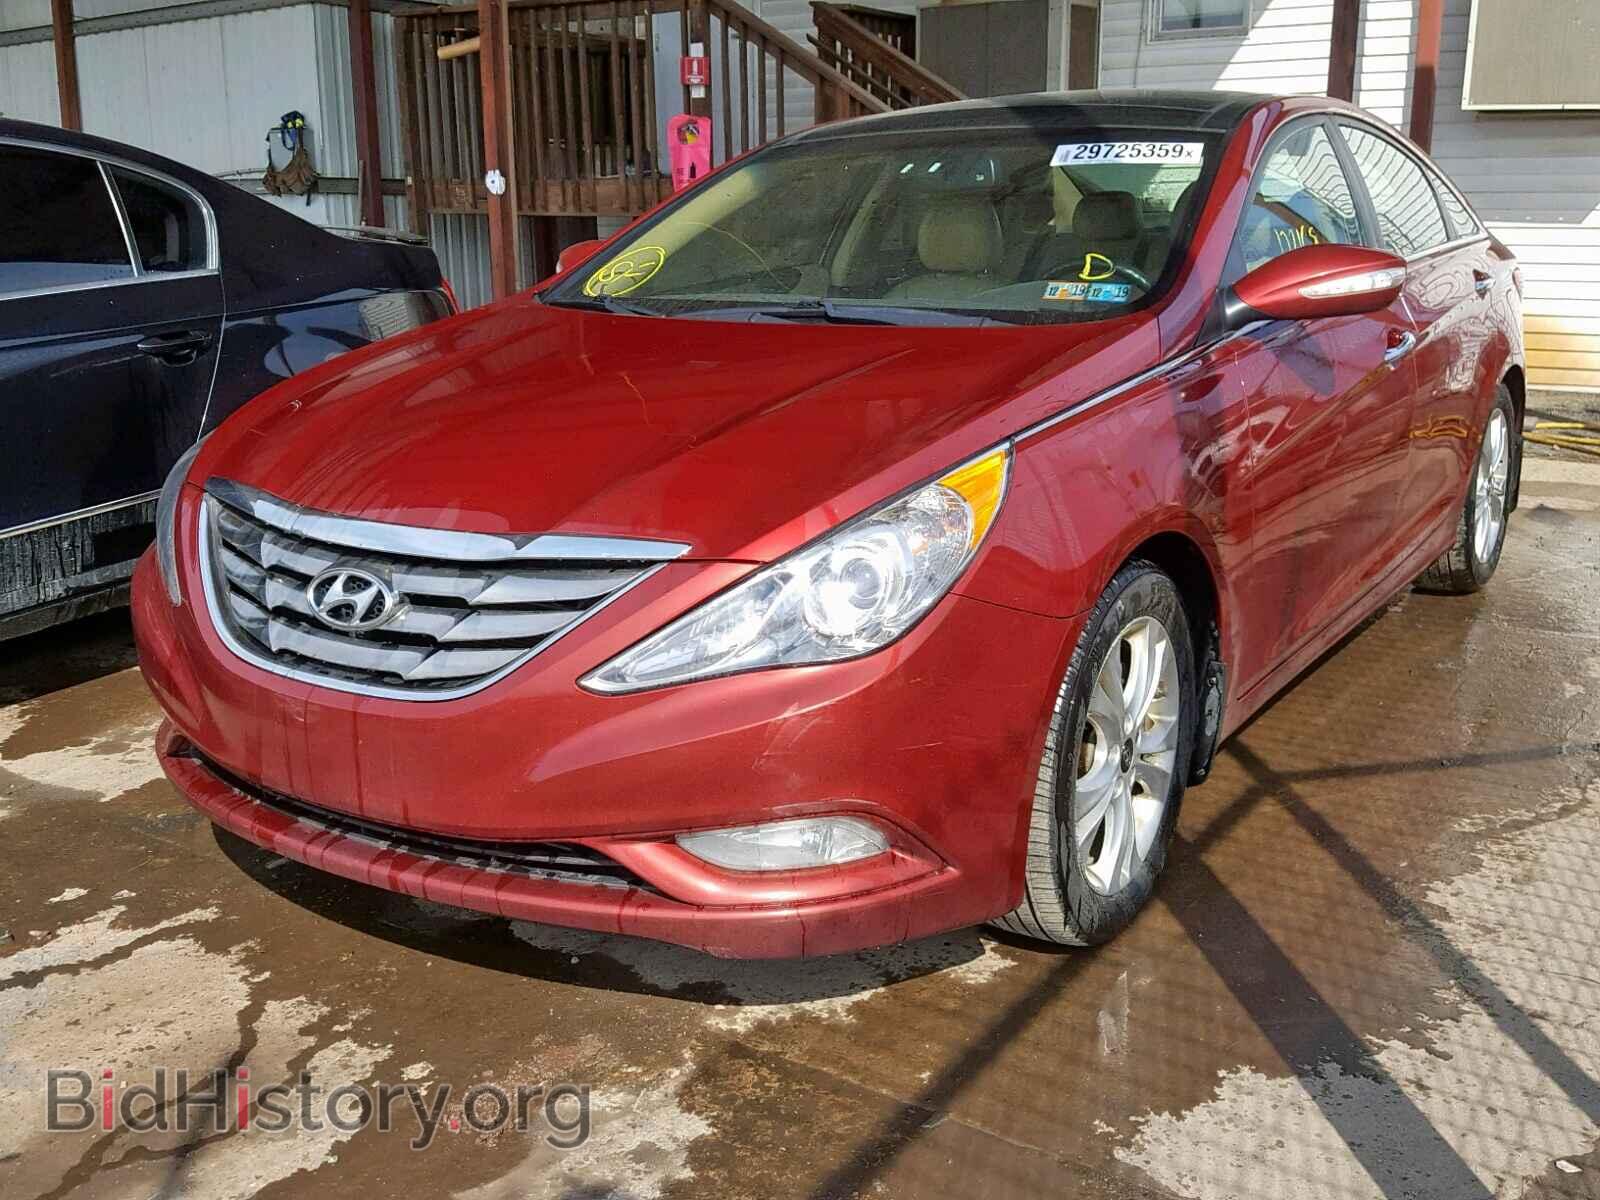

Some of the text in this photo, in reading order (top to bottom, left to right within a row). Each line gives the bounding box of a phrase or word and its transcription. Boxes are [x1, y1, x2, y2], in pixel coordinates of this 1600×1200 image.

[1078, 252, 1116, 280] D
[1072, 284, 1086, 296] 19
[1115, 286, 1129, 298] 19
